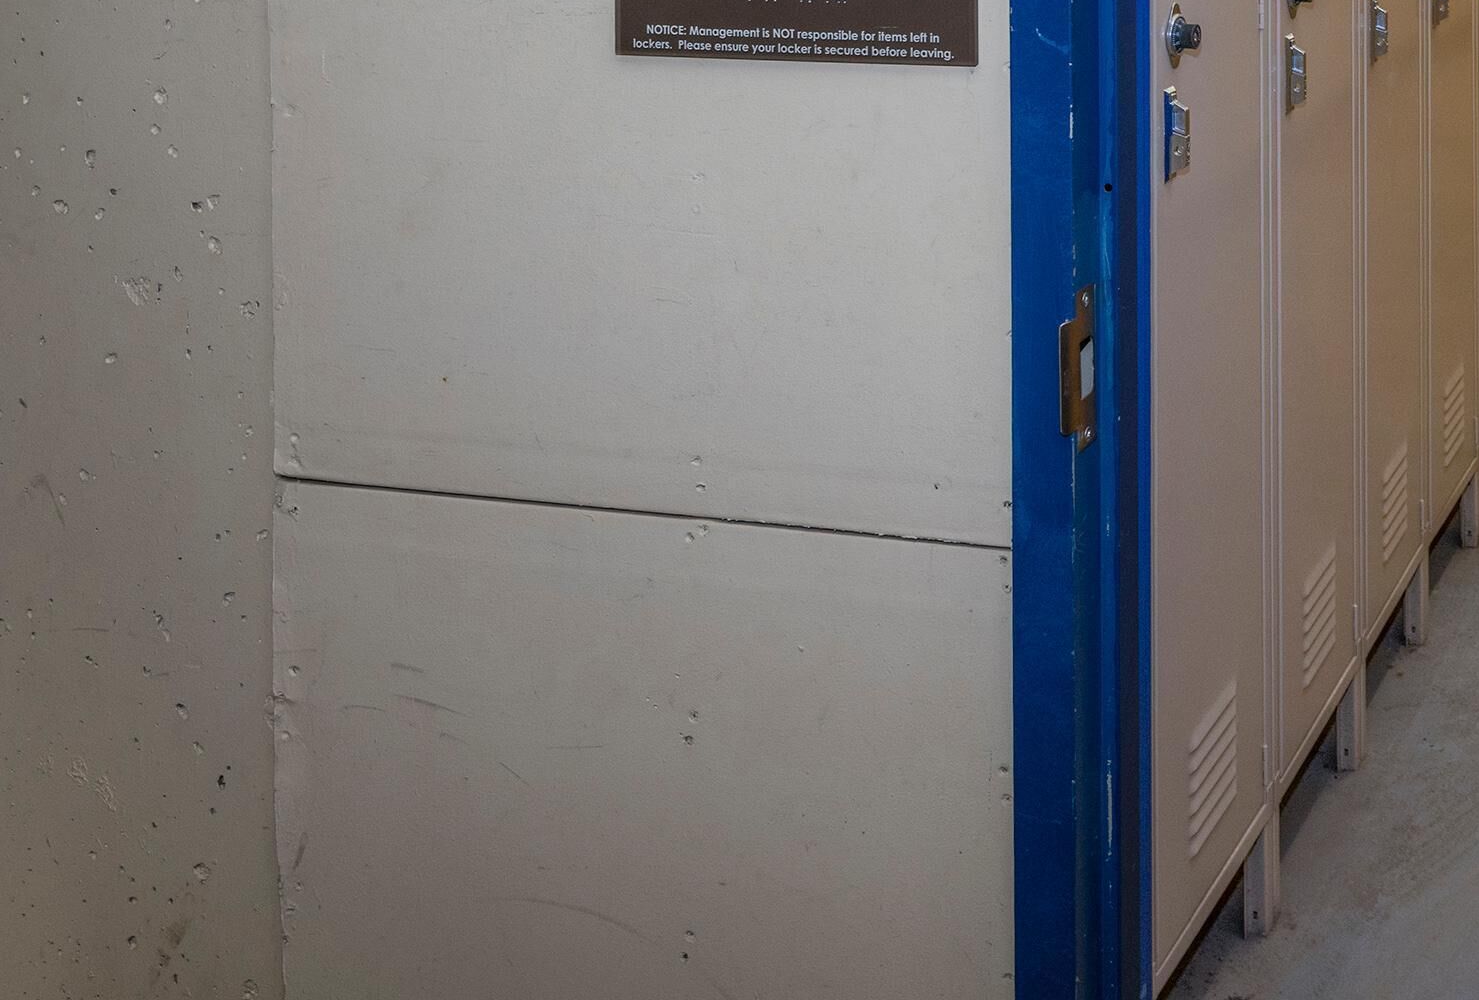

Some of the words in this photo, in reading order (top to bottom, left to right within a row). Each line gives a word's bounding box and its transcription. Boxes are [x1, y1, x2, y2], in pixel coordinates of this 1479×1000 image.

[646, 24, 687, 35] NOTICE:
[689, 26, 760, 38] Management
[762, 27, 770, 38] is
[773, 28, 795, 39] NOT
[797, 30, 858, 41] responsible
[861, 30, 875, 41] for
[878, 31, 907, 42] items
[910, 32, 927, 43] left
[930, 33, 940, 43] in
[633, 38, 673, 49] lockers.
[678, 39, 712, 50] Please
[714, 42, 749, 52] ensure
[751, 44, 775, 54] your
[777, 43, 812, 54] locker
[814, 44, 822, 54] is
[824, 44, 868, 56] secured
[871, 46, 907, 57] before
[910, 47, 955, 61] leaving.
